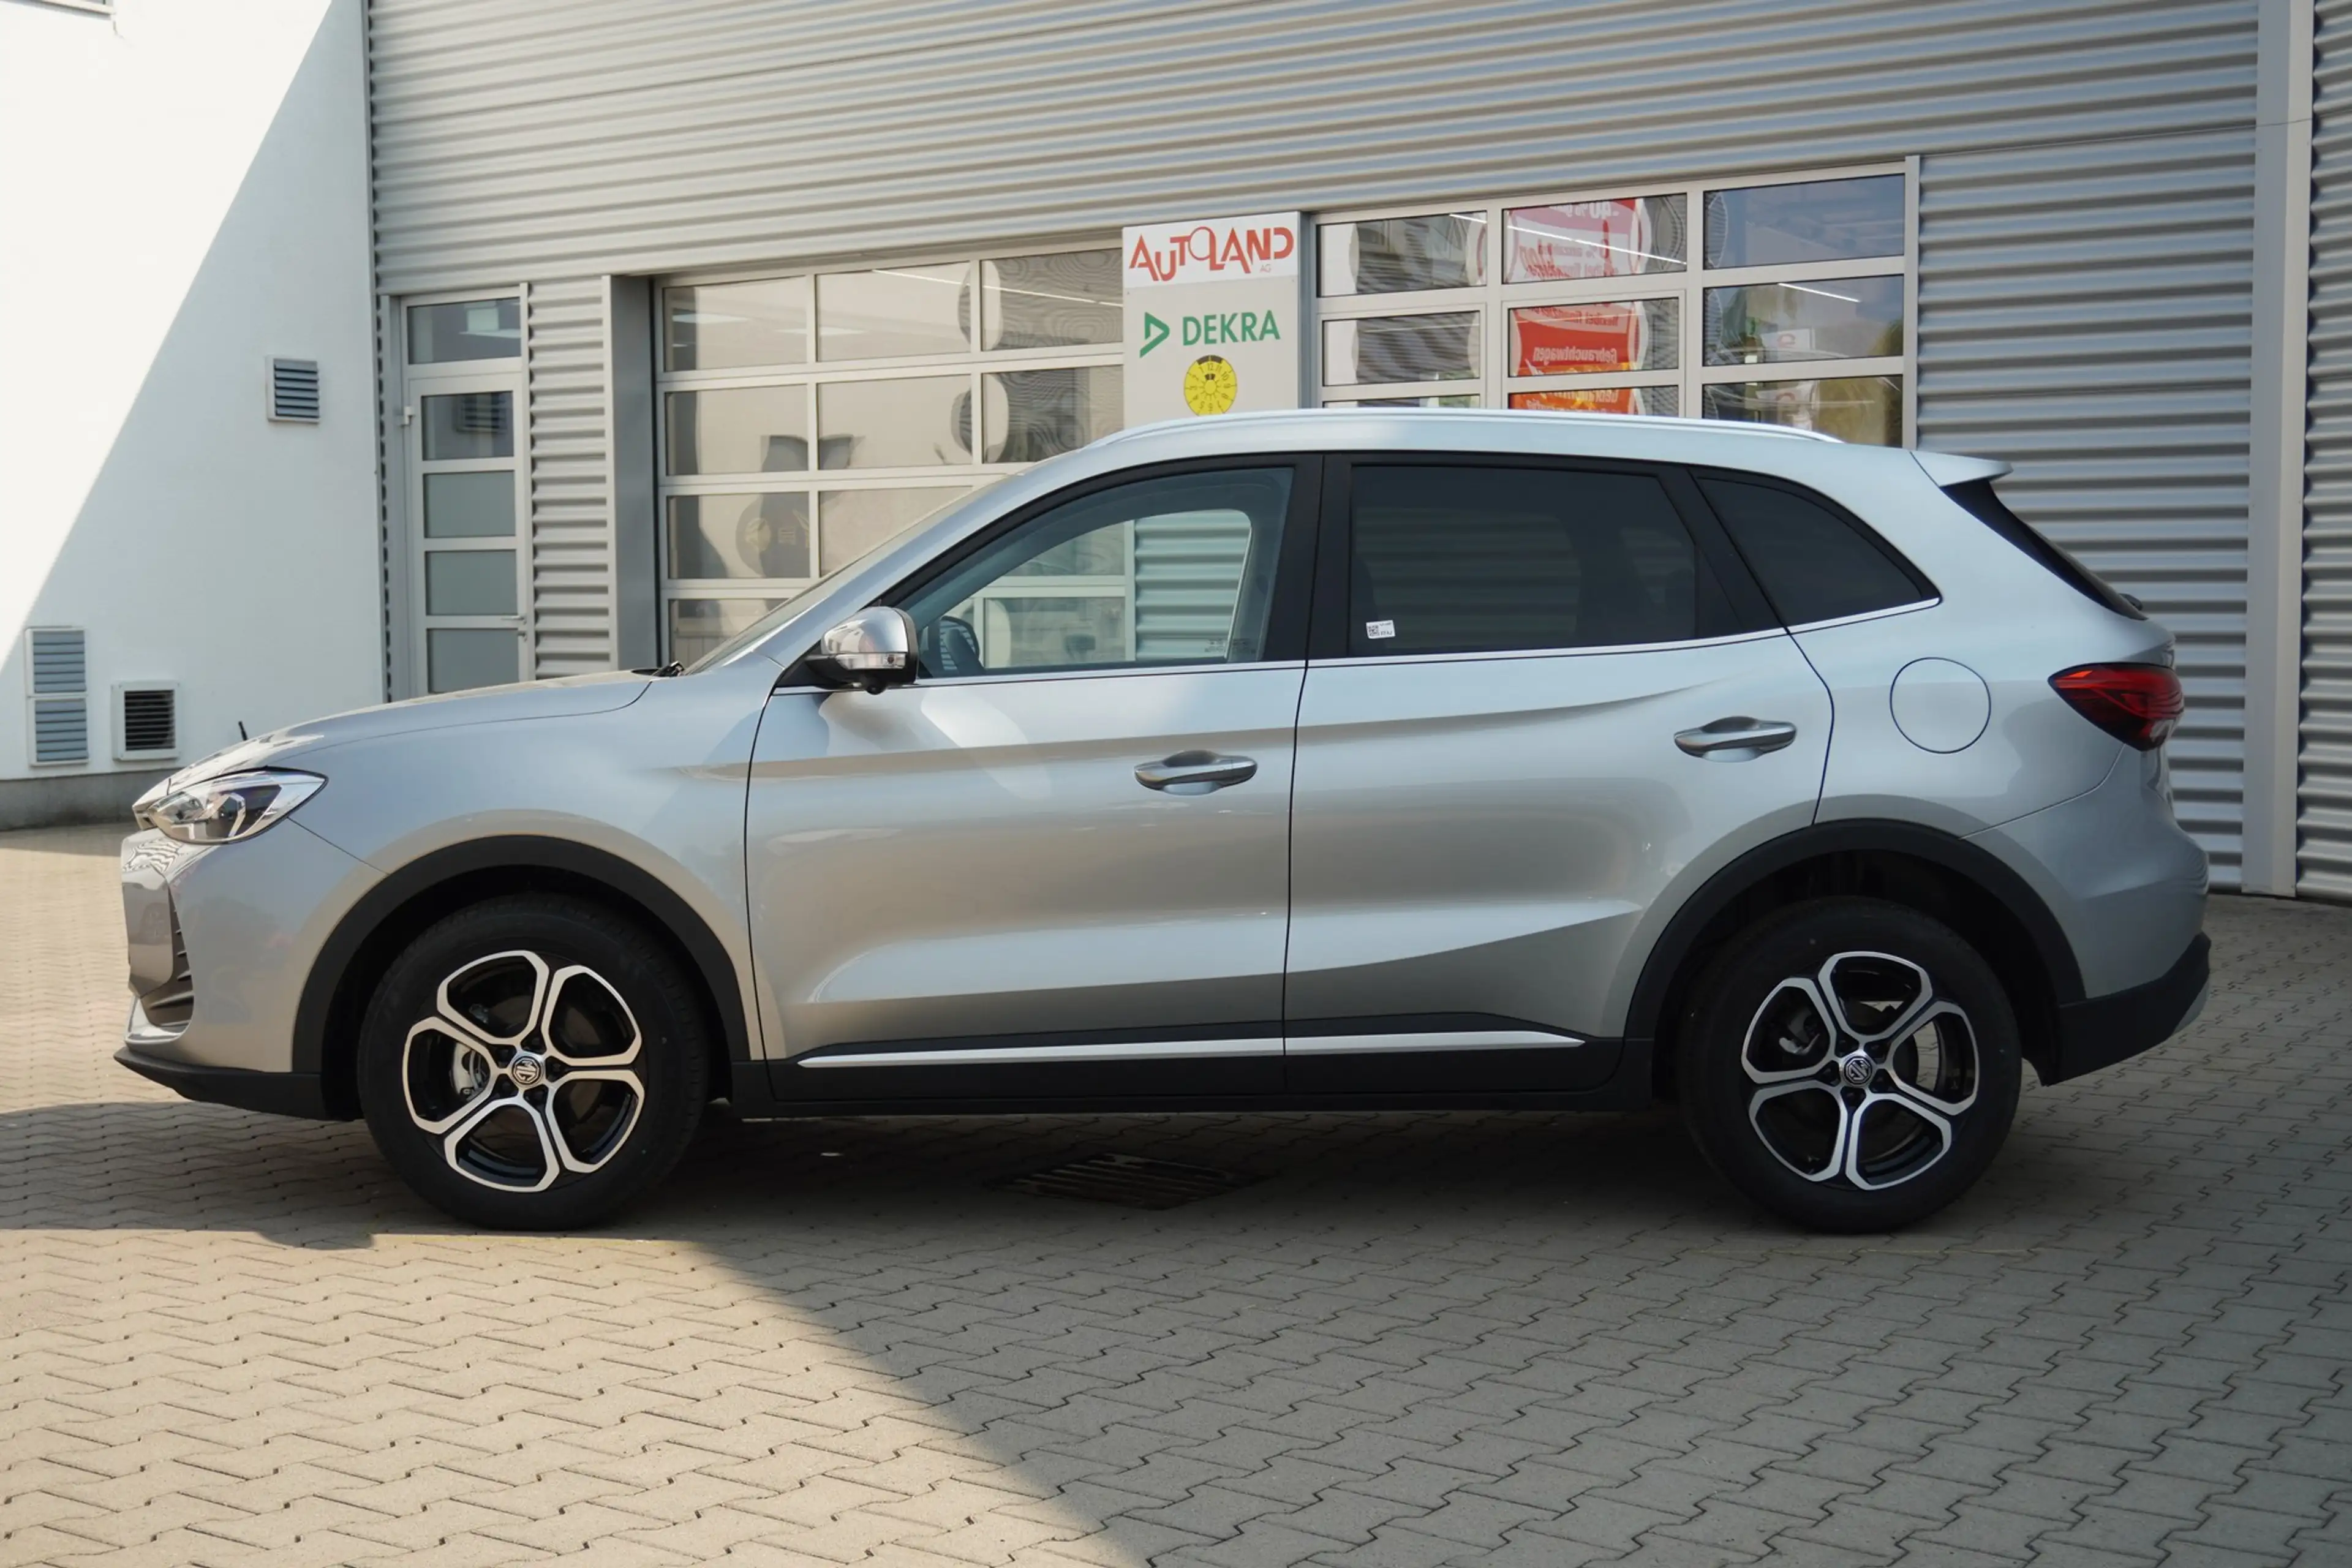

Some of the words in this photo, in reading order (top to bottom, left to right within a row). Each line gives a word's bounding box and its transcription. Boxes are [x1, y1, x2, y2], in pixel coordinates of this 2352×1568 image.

[1129, 226, 1294, 281] AUTOLAND
[1260, 263, 1272, 273] AG
[1182, 310, 1281, 346] DEKRA
[515, 1060, 537, 1082] MG
